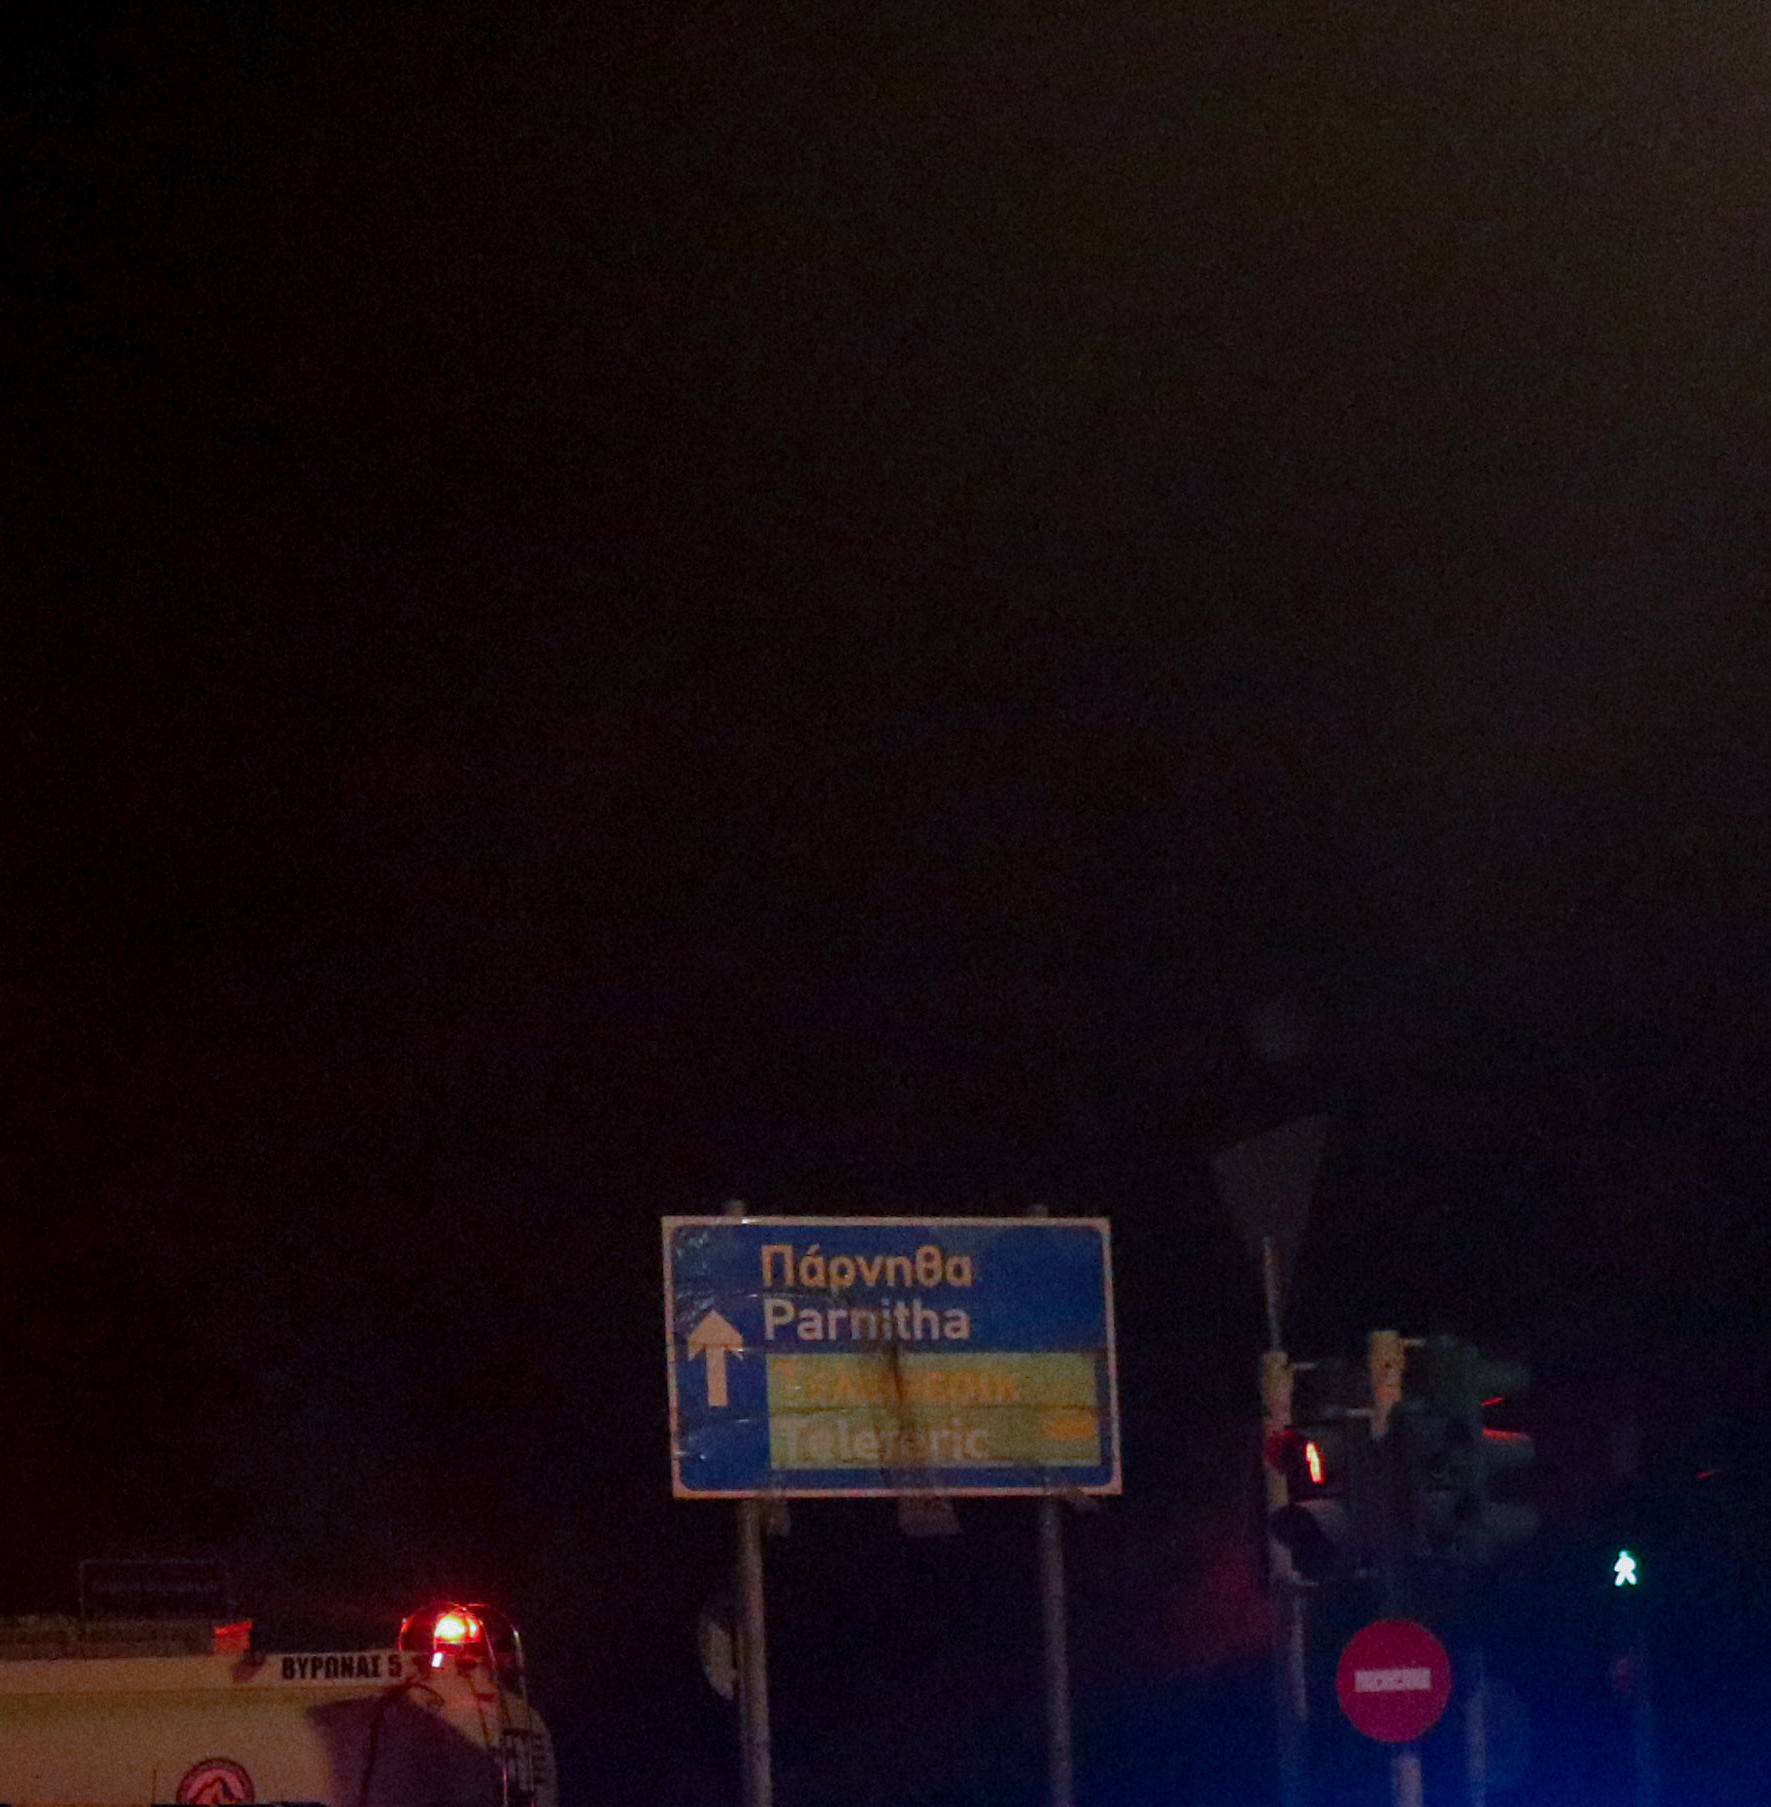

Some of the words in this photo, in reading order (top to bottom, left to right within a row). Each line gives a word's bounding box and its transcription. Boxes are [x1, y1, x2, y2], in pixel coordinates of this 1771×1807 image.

[761, 1243, 974, 1297] Πάρνηθα
[763, 1298, 972, 1341] Parnitha
[282, 1654, 381, 1680] ΒΥΡΩΝΑΣ
[388, 1653, 402, 1677] 5
